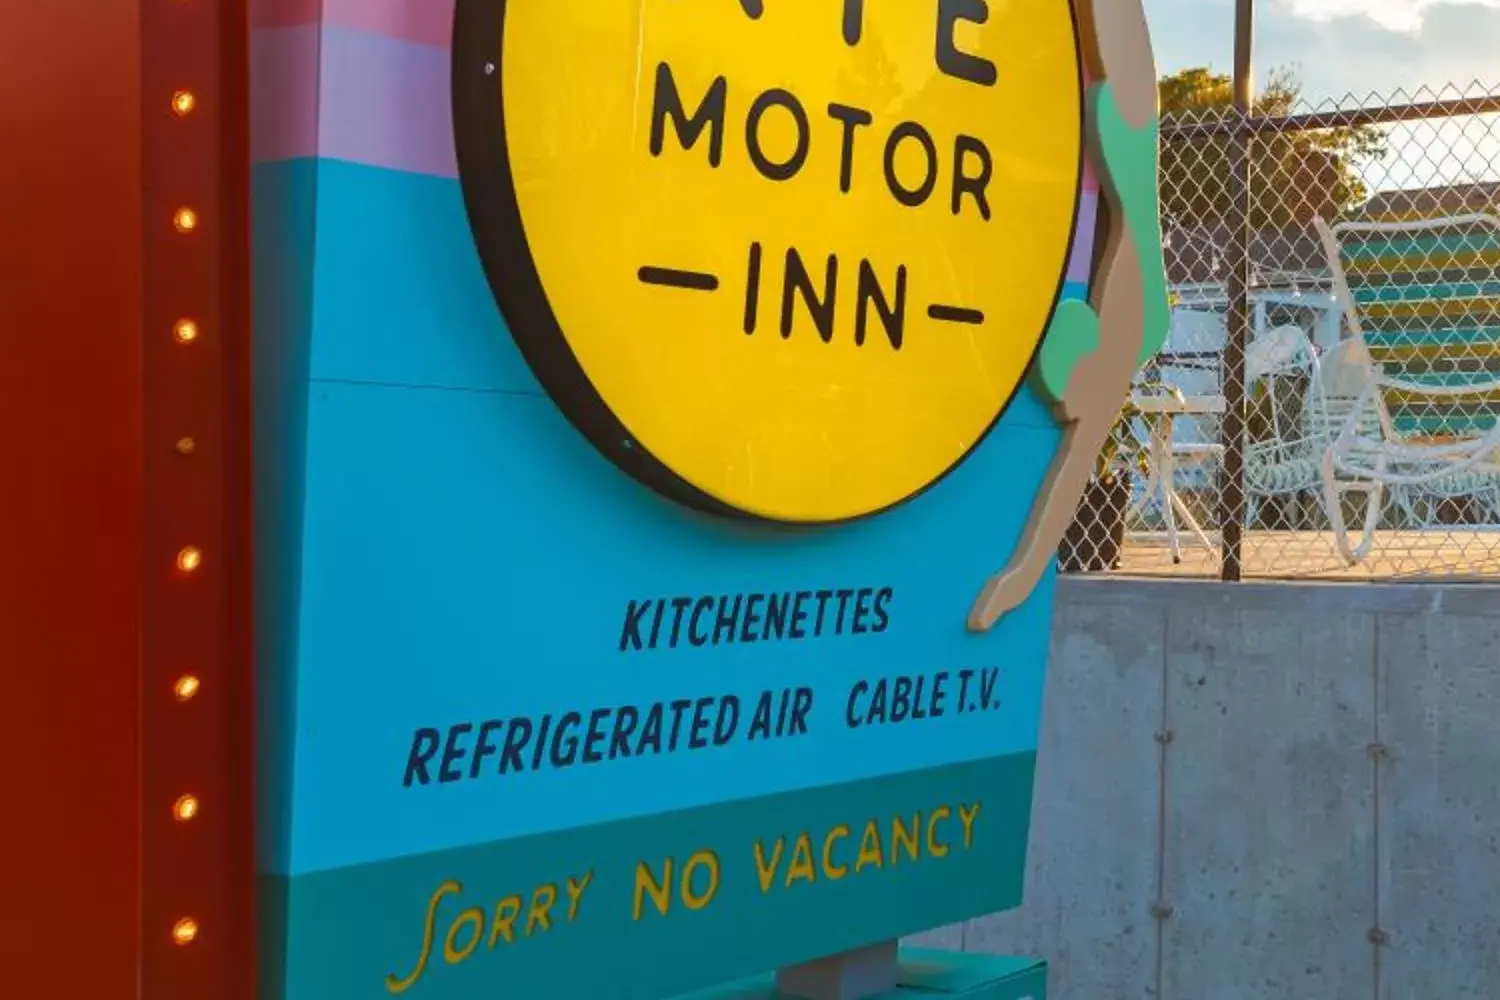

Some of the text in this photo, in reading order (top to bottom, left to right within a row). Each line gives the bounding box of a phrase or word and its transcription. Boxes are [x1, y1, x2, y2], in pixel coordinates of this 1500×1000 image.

[649, 61, 992, 221] MOTOR
[618, 586, 894, 652] KITCHENETTES
[402, 686, 814, 788] REFRIGERATED AIR
[845, 665, 1002, 729] CABLE T.V.
[385, 800, 983, 994] SORRY NO VACANCY
